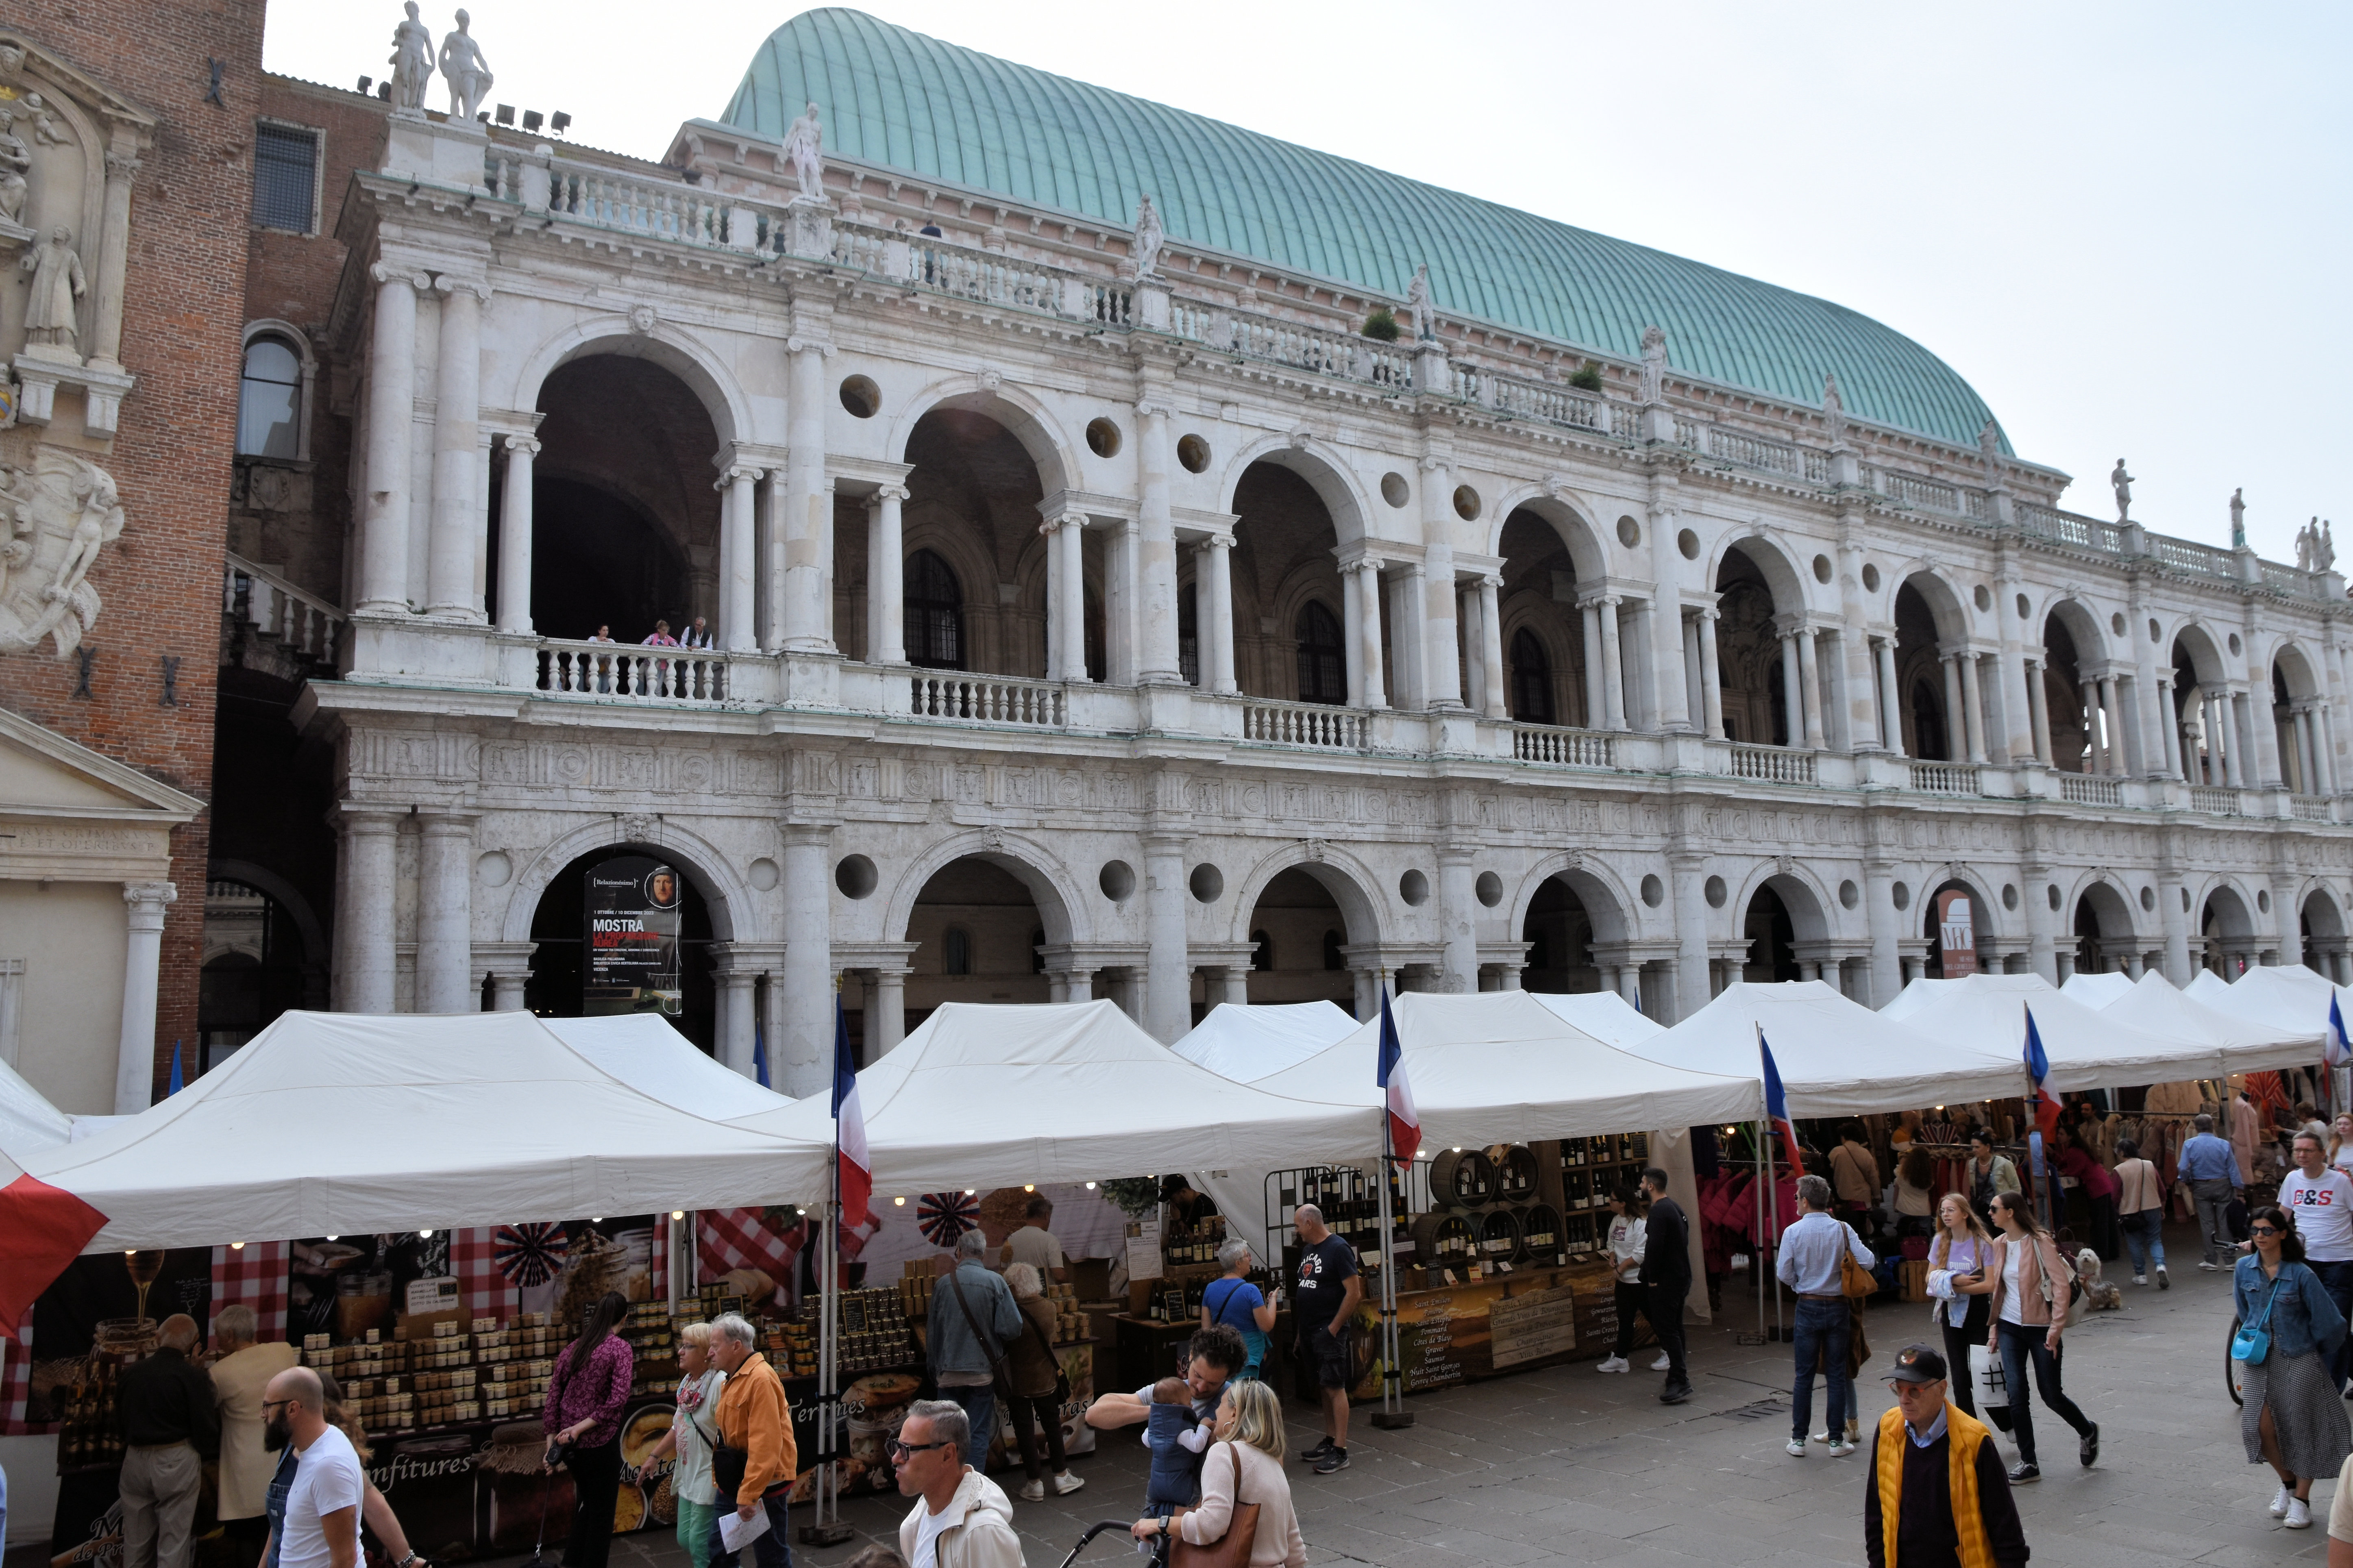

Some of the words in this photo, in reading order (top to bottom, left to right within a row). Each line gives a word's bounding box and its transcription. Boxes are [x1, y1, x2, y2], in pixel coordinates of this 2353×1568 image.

[63, 829, 151, 839] GRIMANVS
[62, 840, 136, 851] OPERIBVS
[593, 919, 644, 932] MOSTRA
[605, 932, 659, 940] PROPORZIONE
[593, 939, 618, 947] AUREA
[1297, 1253, 1322, 1274] HICAGO
[1950, 1261, 1971, 1270] PUMA
[1298, 1279, 1317, 1289] ARS
[1431, 1297, 1451, 1305] Emilion
[1493, 1299, 1516, 1315] Grands
[1517, 1298, 1530, 1307] Vins
[1532, 1295, 1539, 1303] de
[1493, 1313, 1516, 1327] Grands
[1517, 1311, 1530, 1320] Vins
[1532, 1307, 1539, 1316] de
[1541, 1303, 1572, 1316] Bourgogne
[1421, 1323, 1448, 1335] Pommard
[1535, 1318, 1561, 1329] Provence
[1429, 1335, 1436, 1344] de
[1437, 1333, 1452, 1344] Blaye
[1517, 1333, 1554, 1347] Champagnes
[1603, 1334, 1618, 1344] Chabl
[1425, 1346, 1444, 1356] Graves
[1519, 1351, 1533, 1359] Vins
[1424, 1355, 1446, 1364] Saumur
[1410, 1366, 1424, 1376] Nuit
[1441, 1362, 1460, 1372] Georges
[1411, 1377, 1429, 1388] Gevrey
[1430, 1371, 1461, 1382] Chambertin
[789, 1398, 866, 1422] Ternes
[1058, 1400, 1088, 1417] ras
[364, 1453, 472, 1494] nfitures
